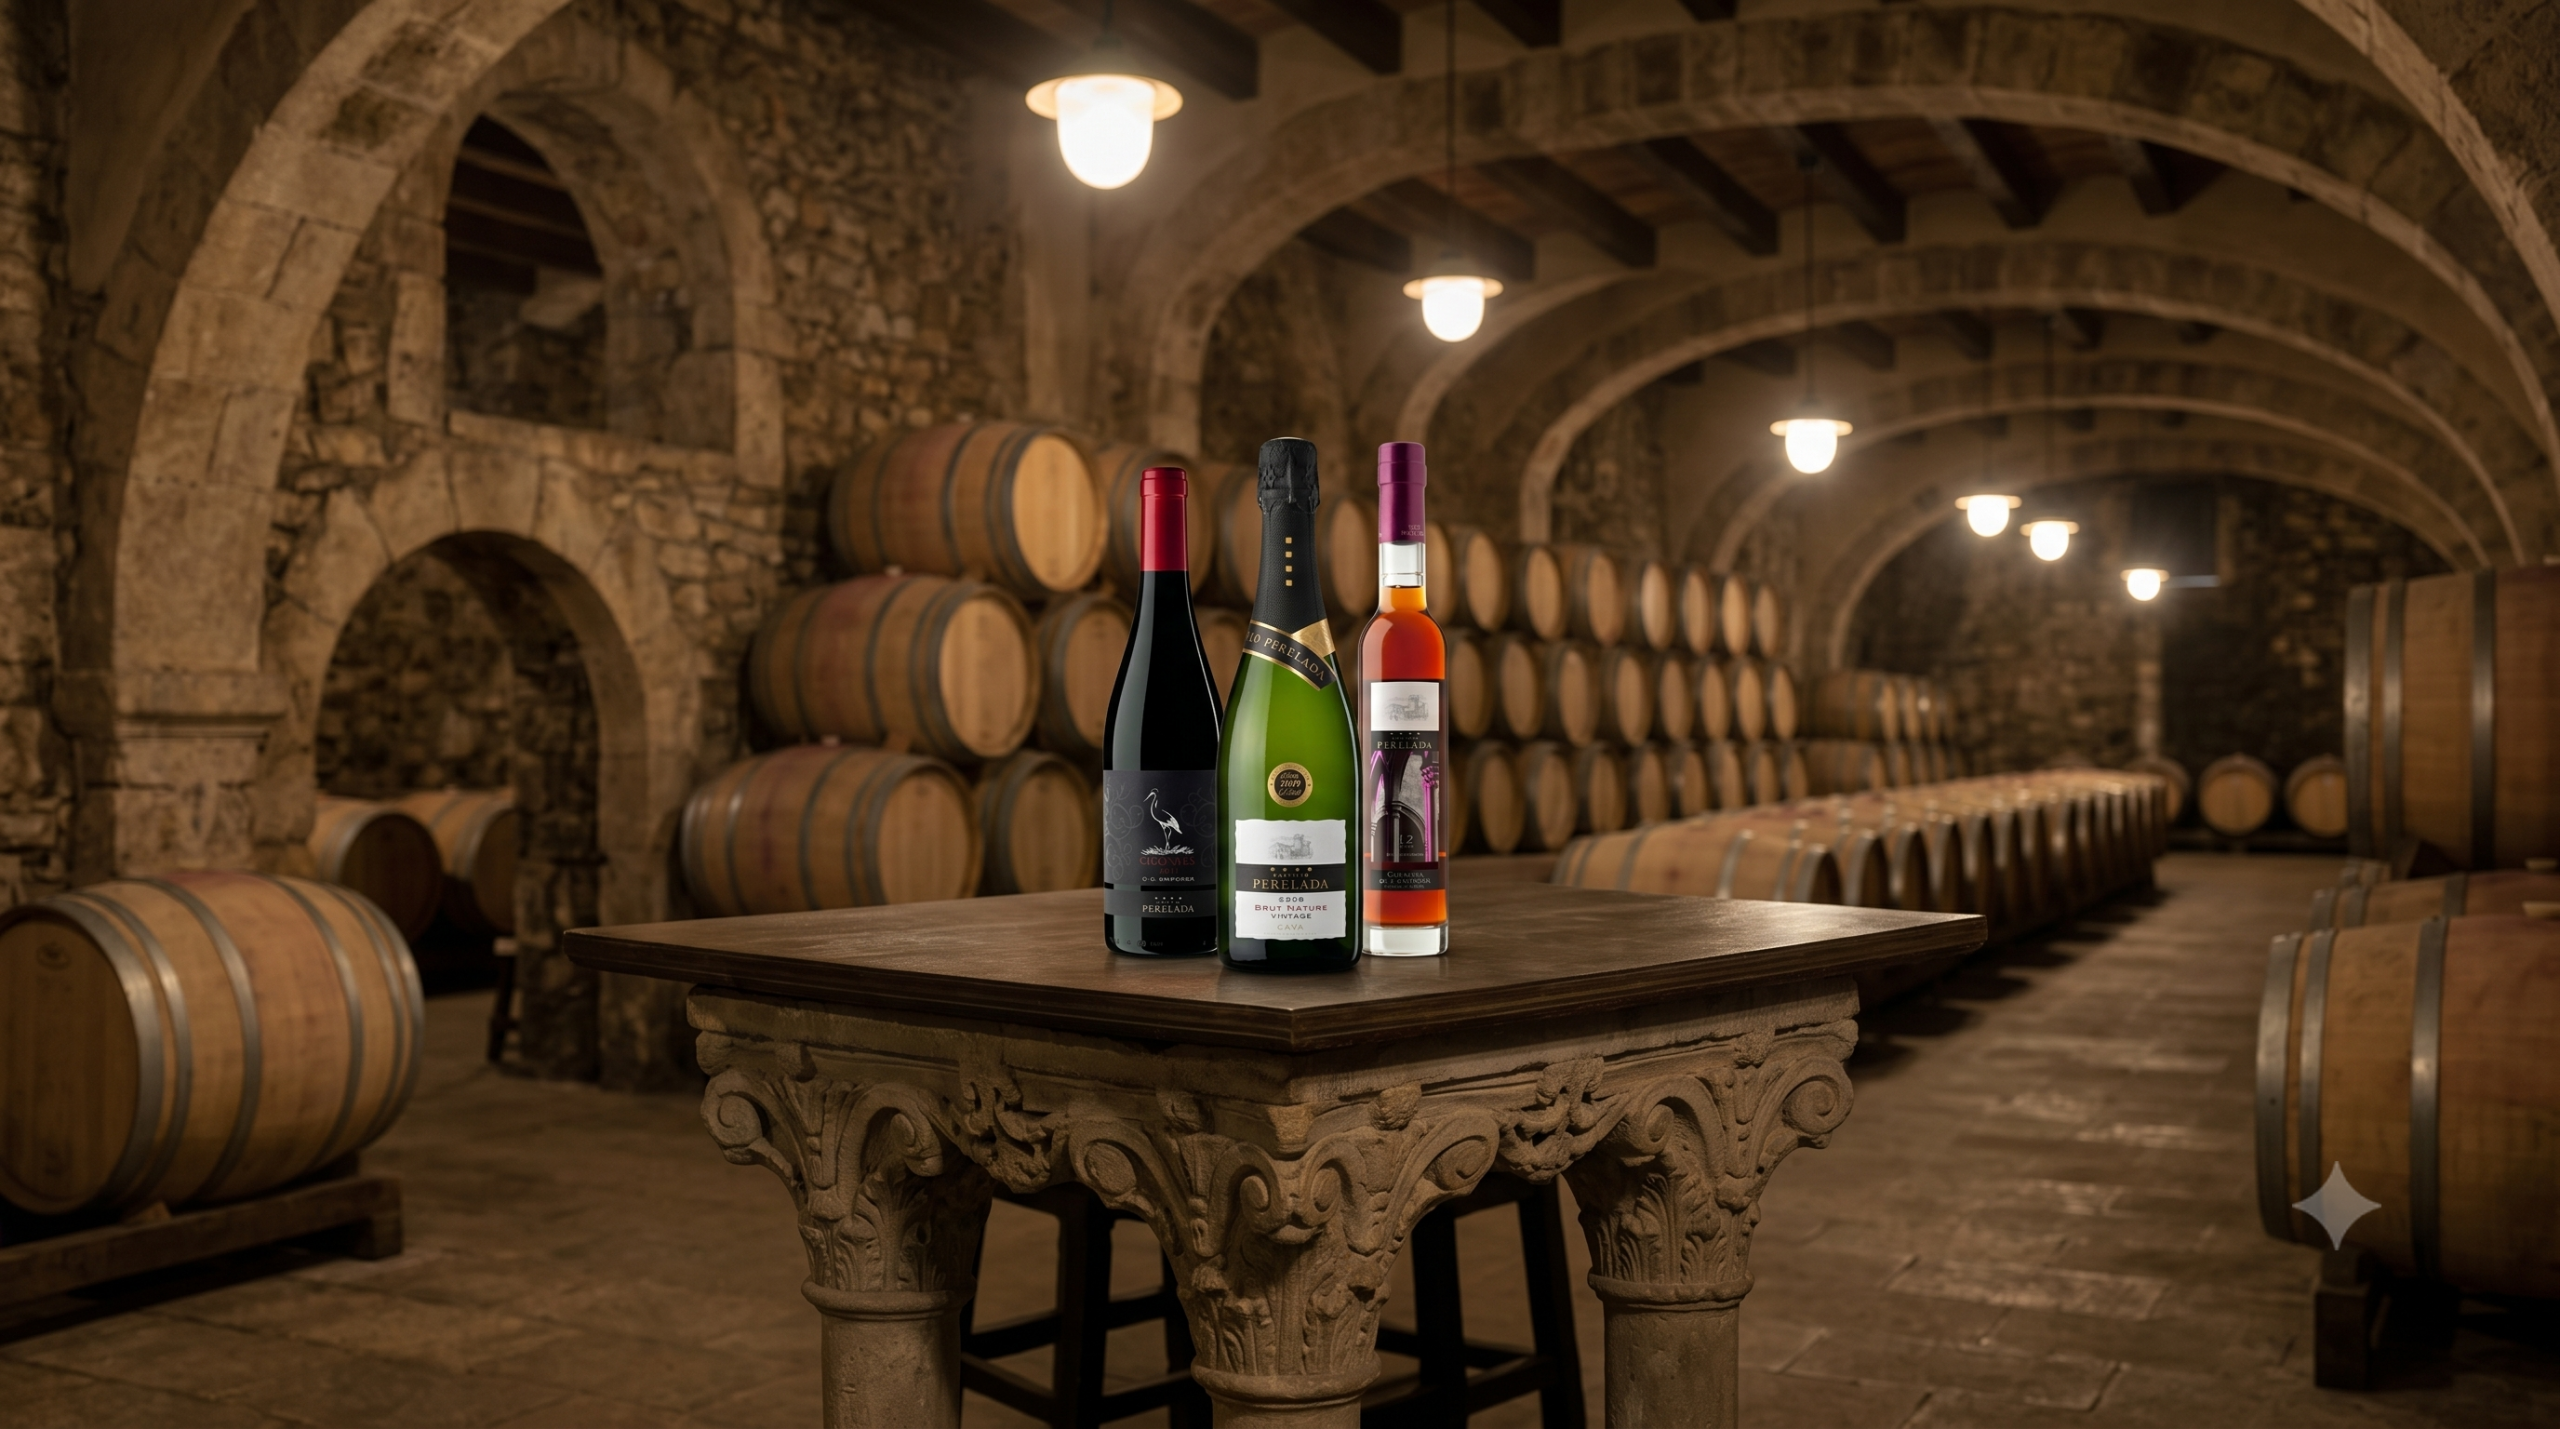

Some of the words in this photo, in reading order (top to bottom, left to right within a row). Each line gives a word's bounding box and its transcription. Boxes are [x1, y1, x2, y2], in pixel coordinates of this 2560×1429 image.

[1263, 637, 1326, 682] PERELADA
[1376, 740, 1432, 750] PERELADA
[1252, 878, 1329, 890] PERELADA
[1142, 904, 1195, 913] PERELADA
[1286, 904, 1328, 912] NATURE
